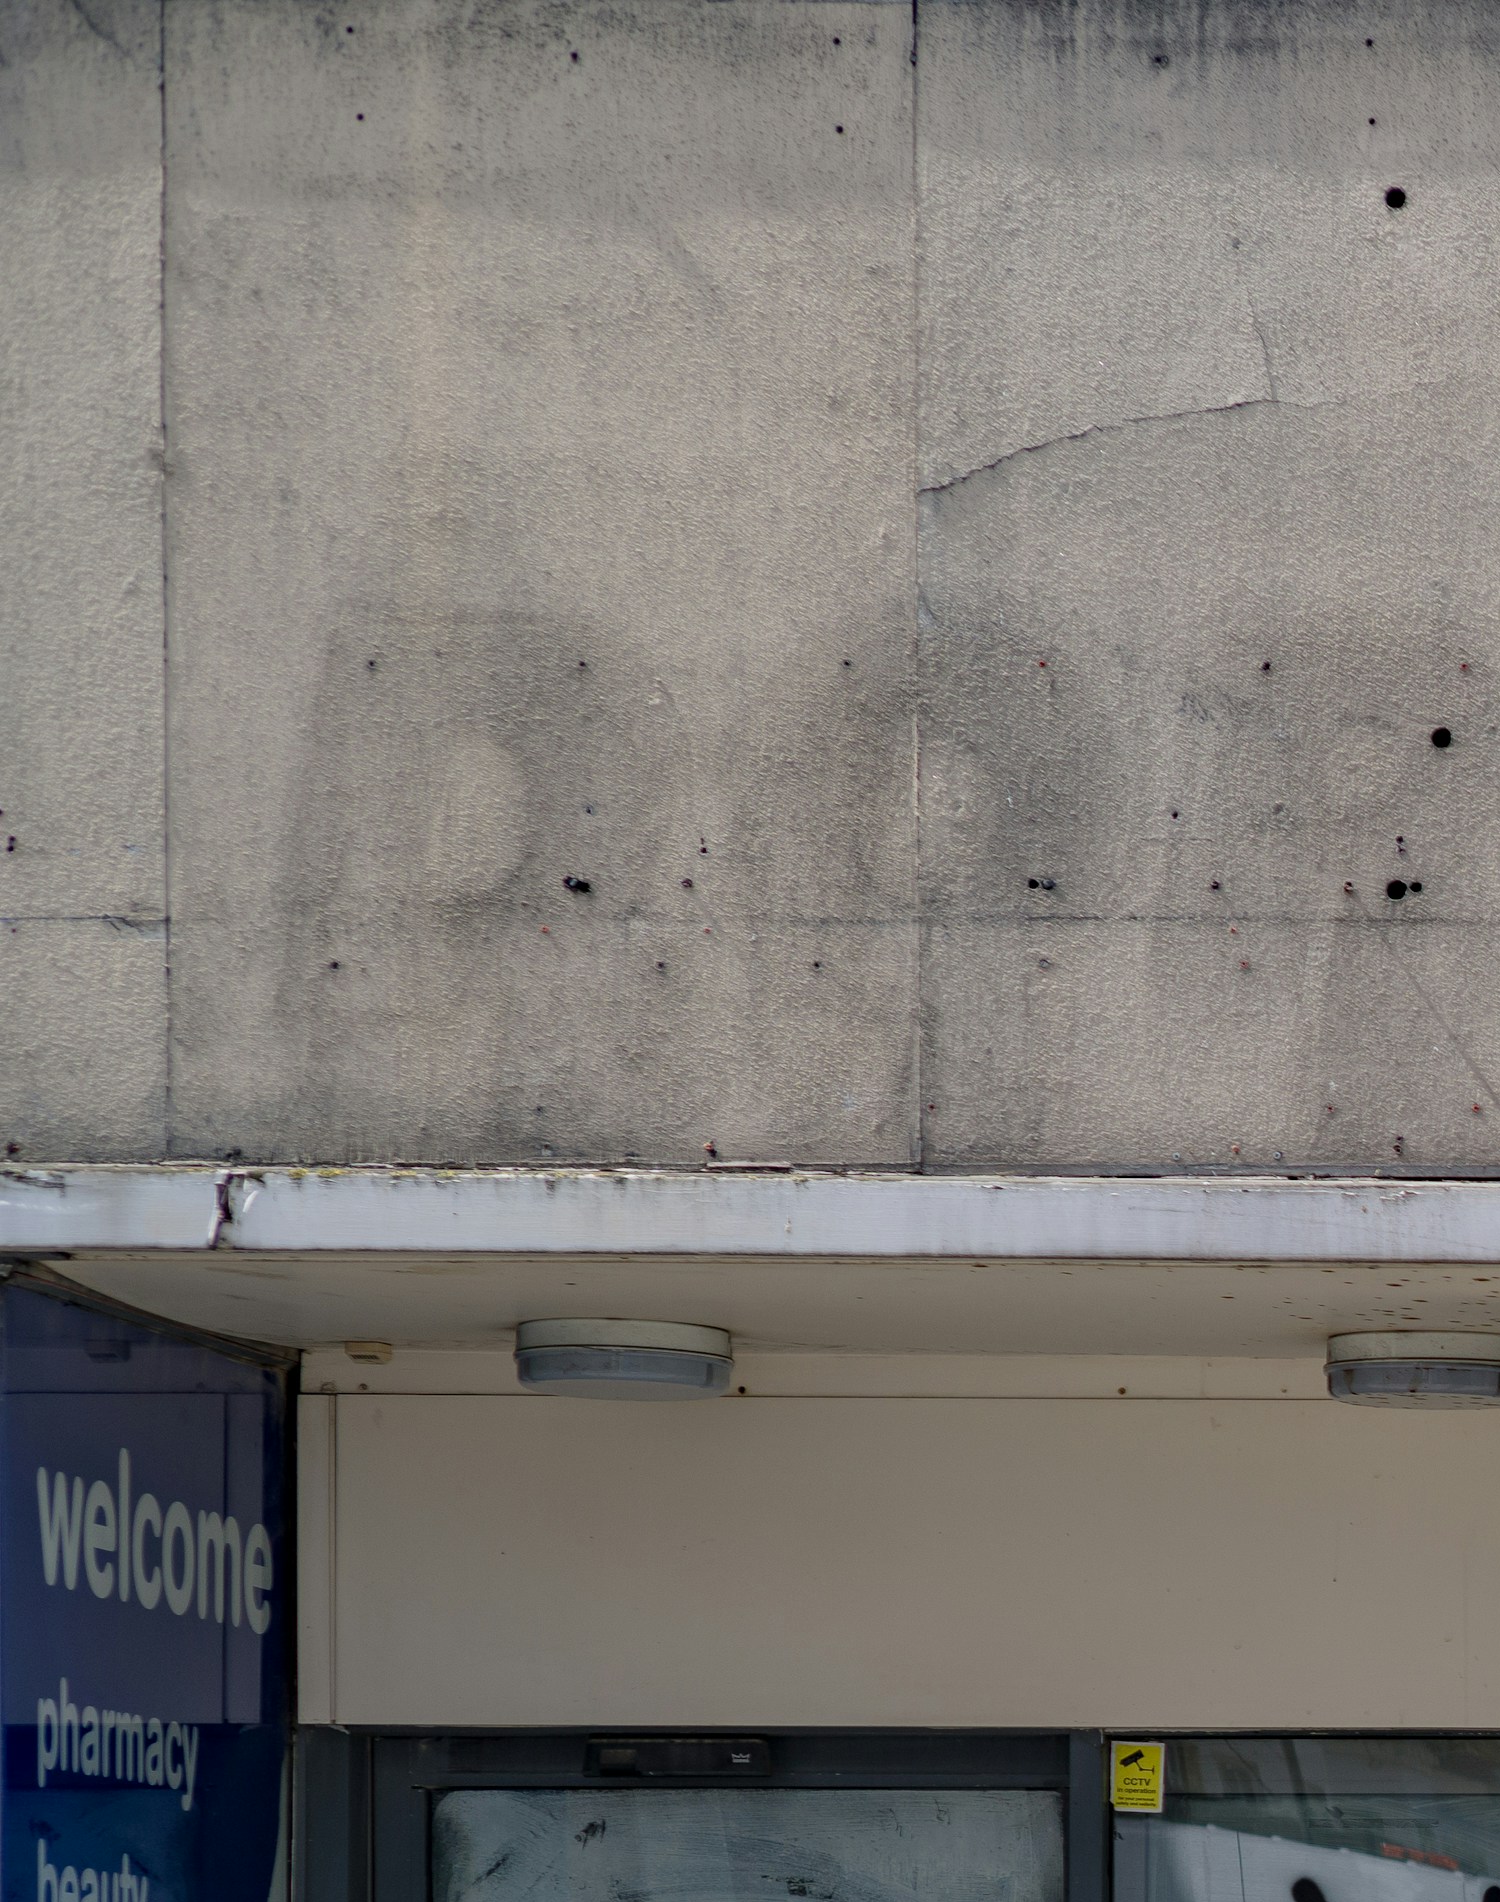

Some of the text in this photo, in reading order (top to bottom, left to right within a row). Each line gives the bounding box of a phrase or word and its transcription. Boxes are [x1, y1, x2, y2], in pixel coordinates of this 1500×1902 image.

[36, 1448, 274, 1635] welcome
[36, 1677, 200, 1811] pharmacy
[1123, 1777, 1151, 1786] CCTV
